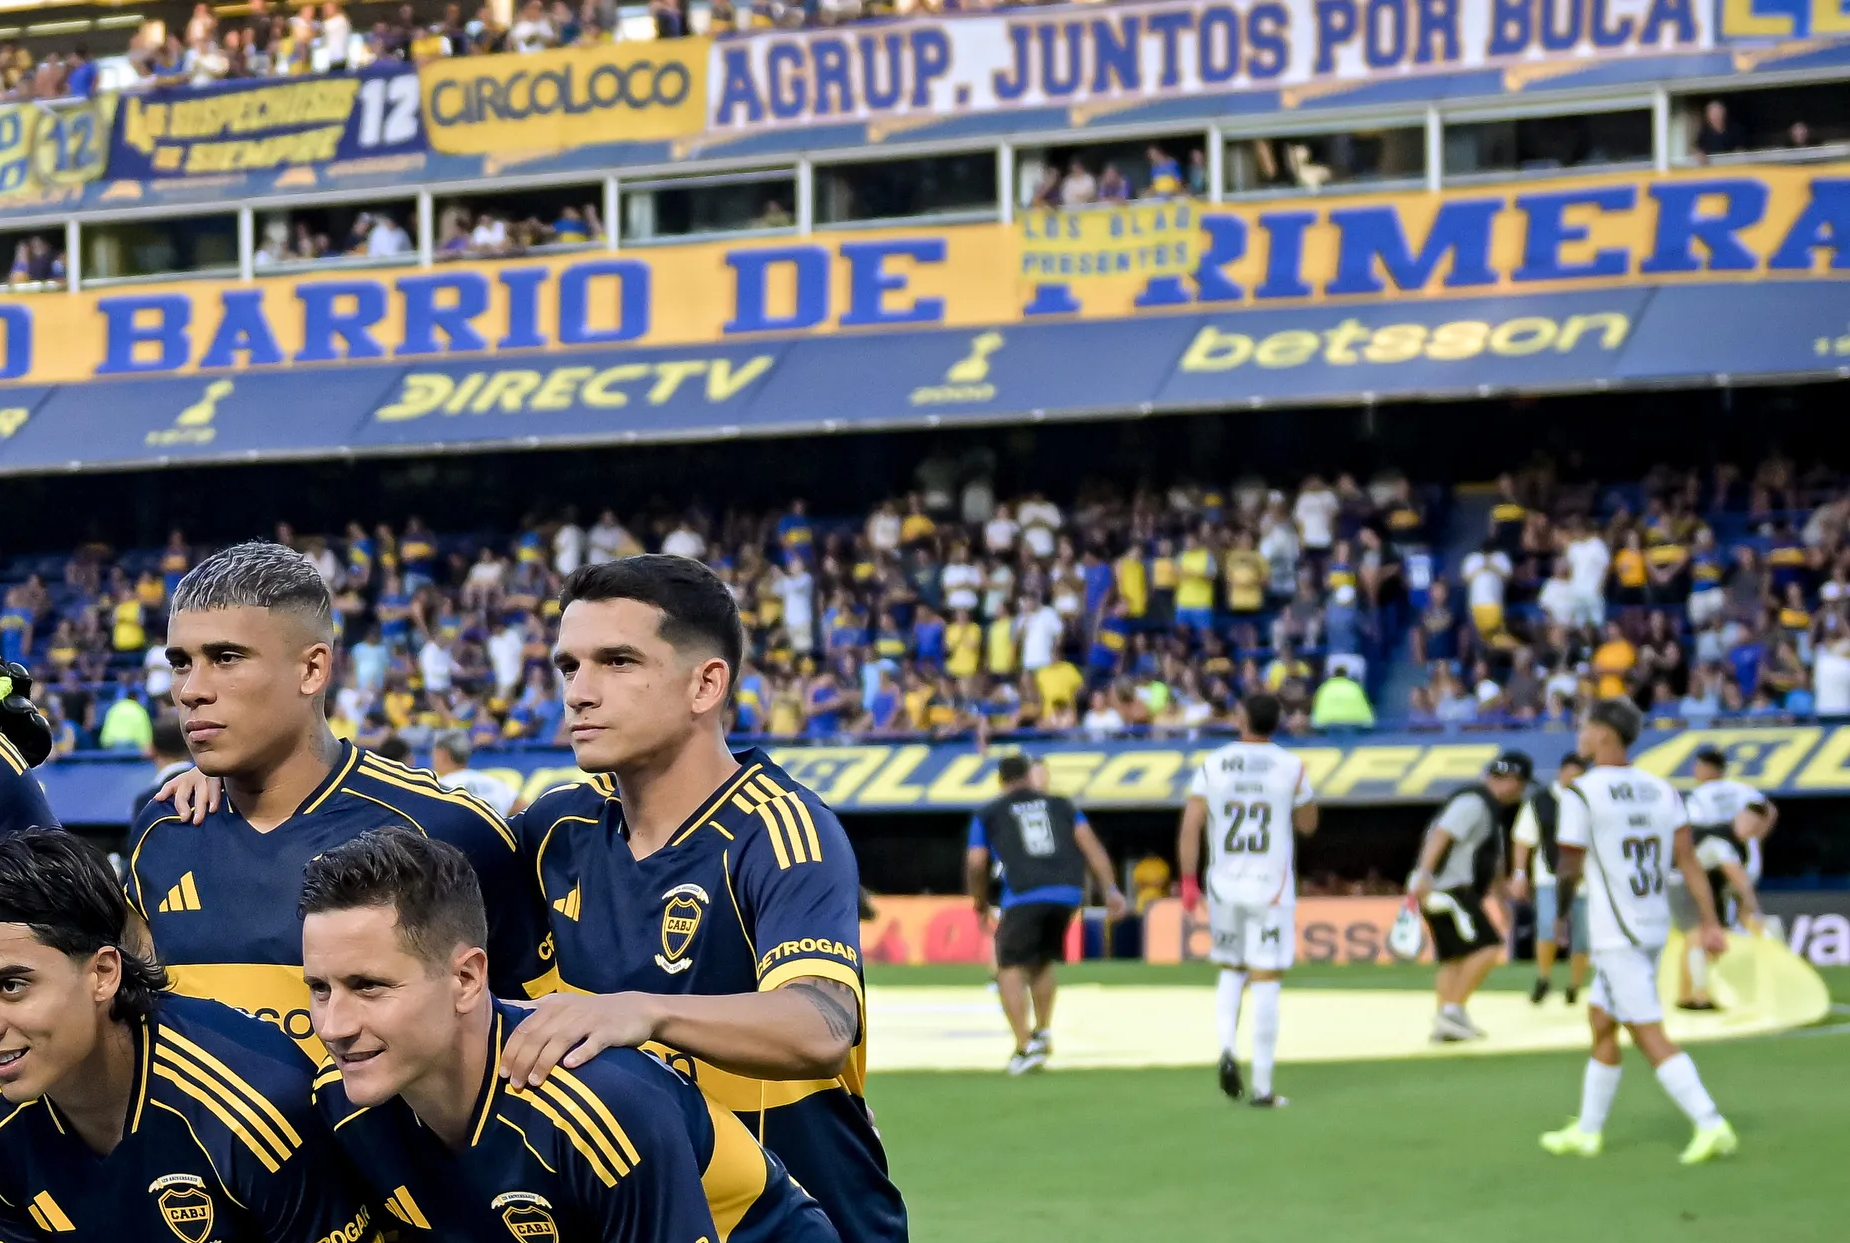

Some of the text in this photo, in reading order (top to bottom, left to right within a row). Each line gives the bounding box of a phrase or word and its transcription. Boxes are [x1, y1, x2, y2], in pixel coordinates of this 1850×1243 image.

[992, 5, 1292, 101] JUNTOS
[1314, 0, 1461, 75] POR
[1487, 0, 1698, 56] BOCA
[357, 74, 420, 149] 12
[430, 60, 692, 128] CIRCOLOCO
[96, 258, 652, 376] BARRIO
[723, 237, 946, 334] DE
[1023, 177, 1850, 316] RIMERA
[1180, 312, 1631, 374] betsson
[375, 356, 777, 422] DIRECTV
[1223, 800, 1272, 855] 23
[667, 919, 693, 932] CABJ
[170, 1207, 207, 1220] CABJ
[516, 1223, 551, 1235] CABJ
